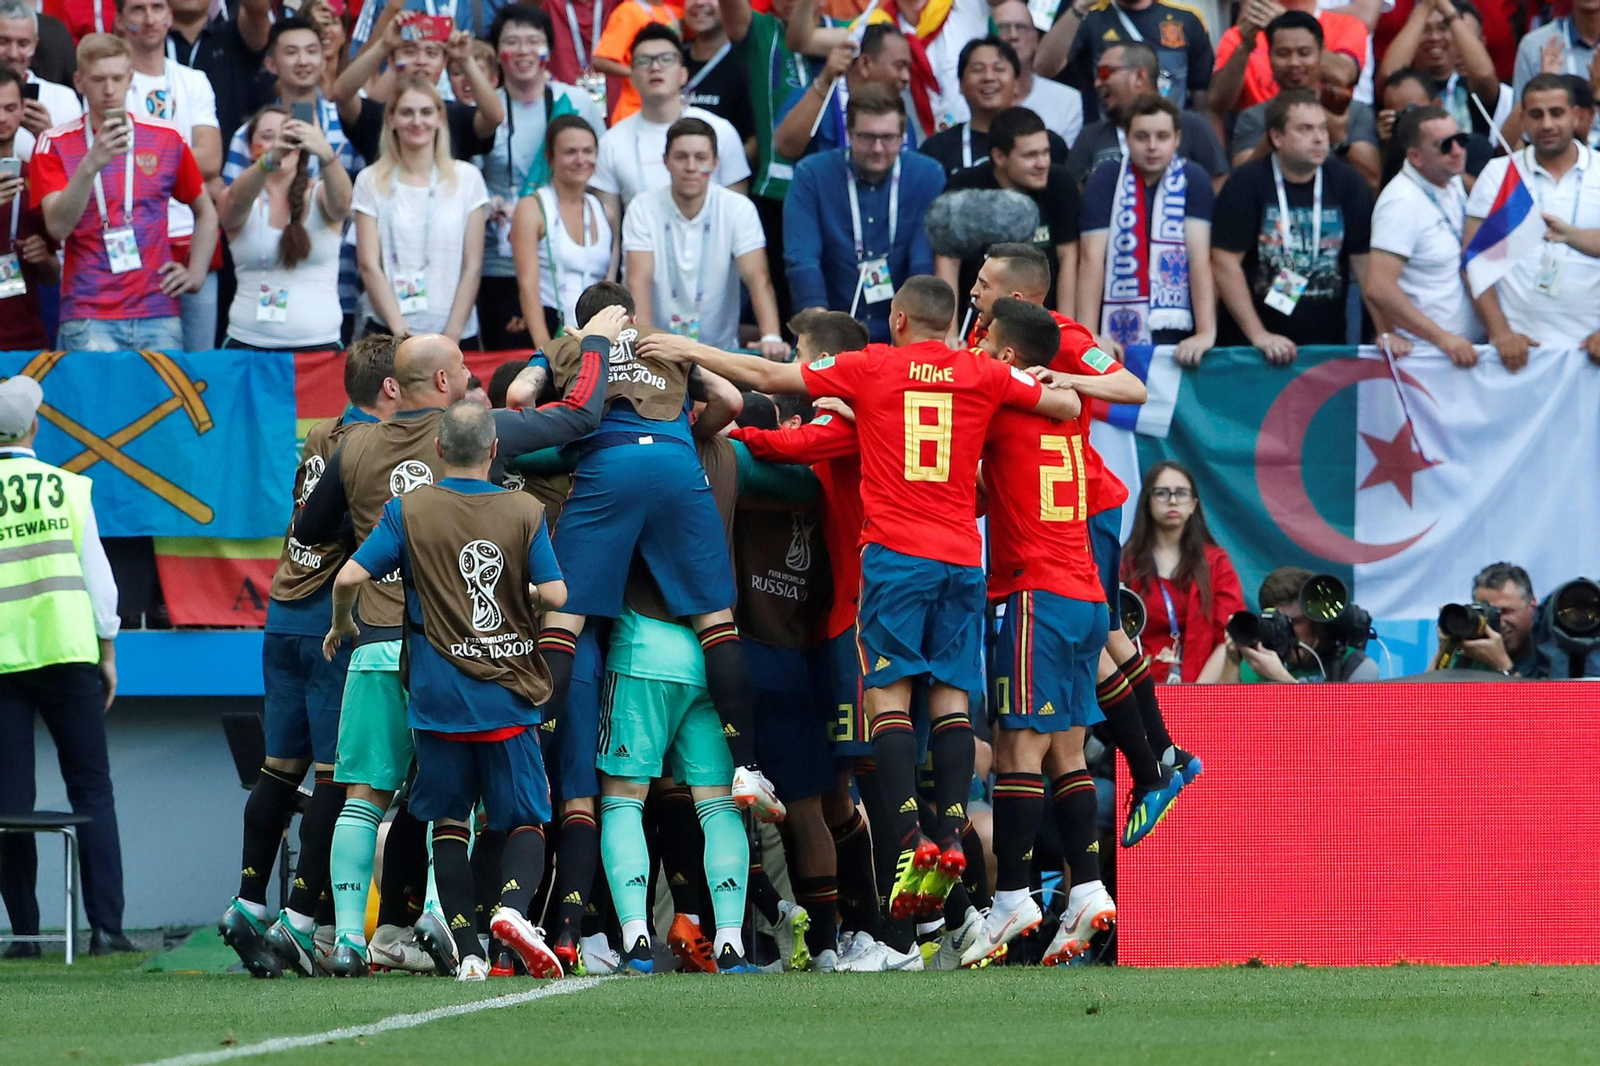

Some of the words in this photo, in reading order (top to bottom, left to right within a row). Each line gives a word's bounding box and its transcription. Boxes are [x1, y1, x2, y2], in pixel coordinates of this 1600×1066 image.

[632, 370, 667, 390] 2018
[904, 391, 953, 482] 8
[1039, 434, 1087, 522] 21
[751, 574, 799, 600] RUSSIA
[503, 632, 519, 641] CUP
